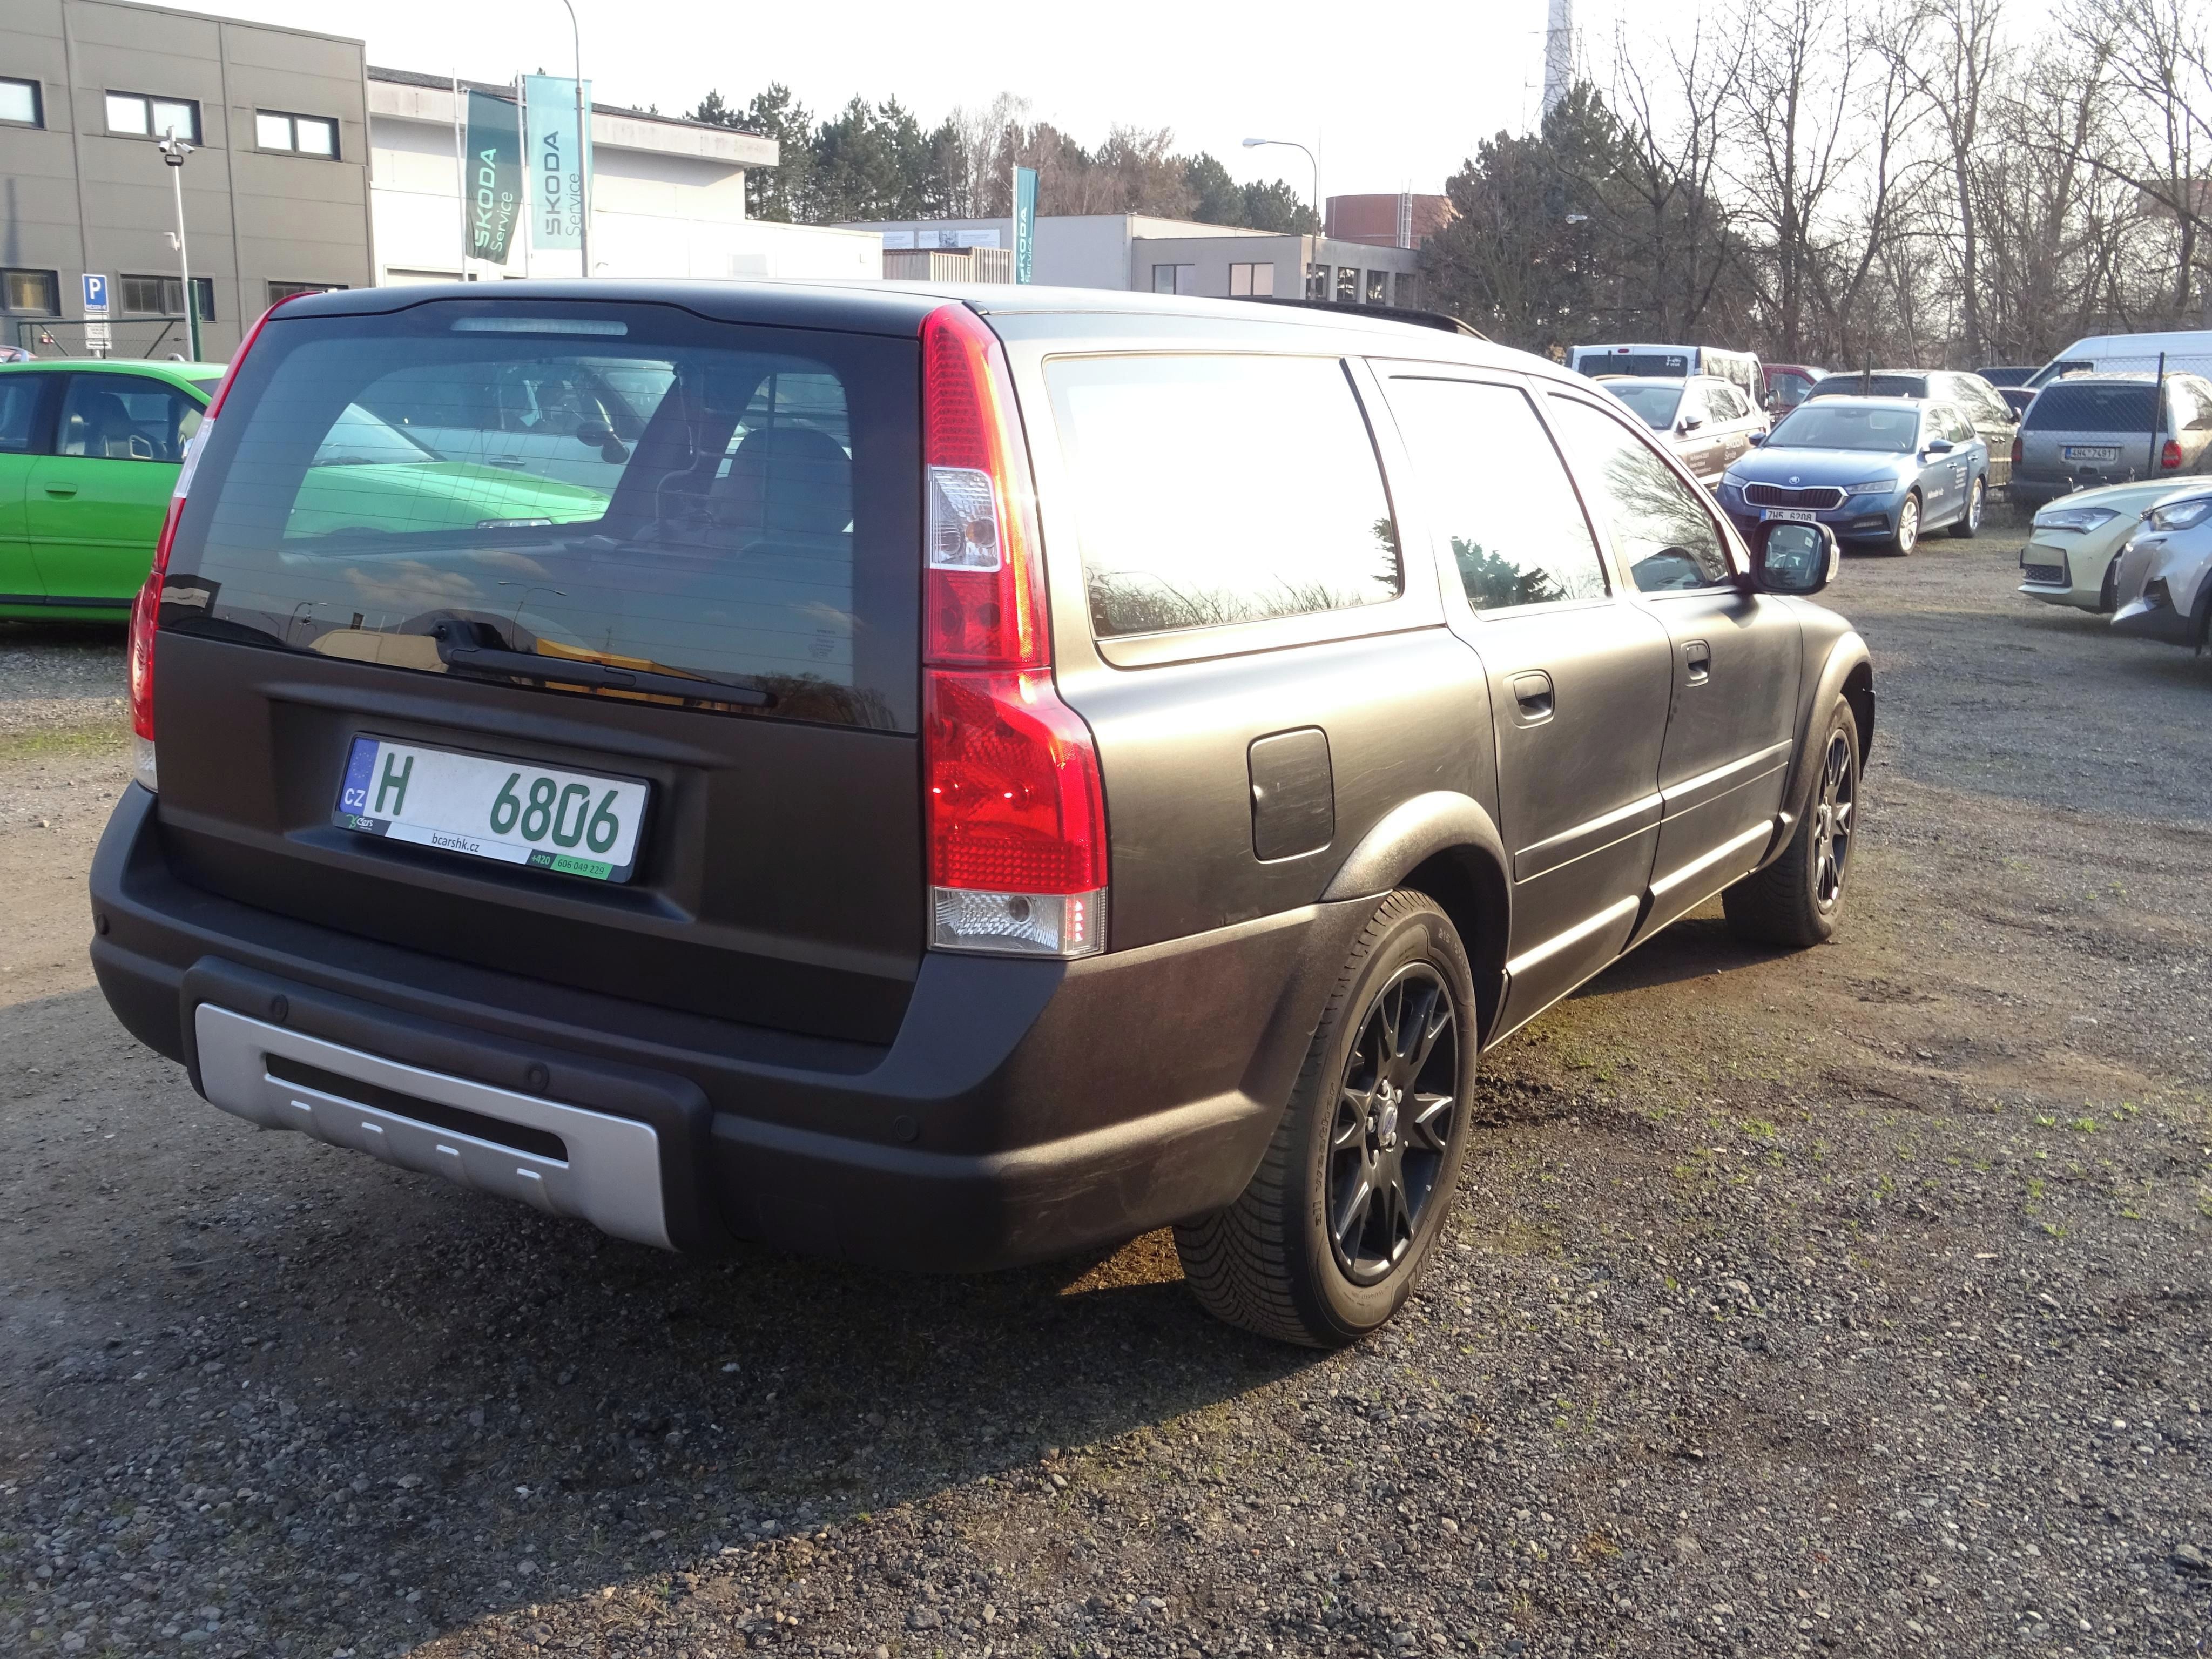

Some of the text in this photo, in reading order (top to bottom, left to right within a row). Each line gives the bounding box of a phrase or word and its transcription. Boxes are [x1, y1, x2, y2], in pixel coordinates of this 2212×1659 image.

[565, 173, 581, 237] Service
[490, 192, 513, 252] Service
[89, 278, 102, 300] P
[344, 788, 366, 807] CZ
[374, 753, 619, 853] H 6806
[432, 833, 480, 852] bcarshk.cz
[531, 855, 604, 875] +420 606 049 229
